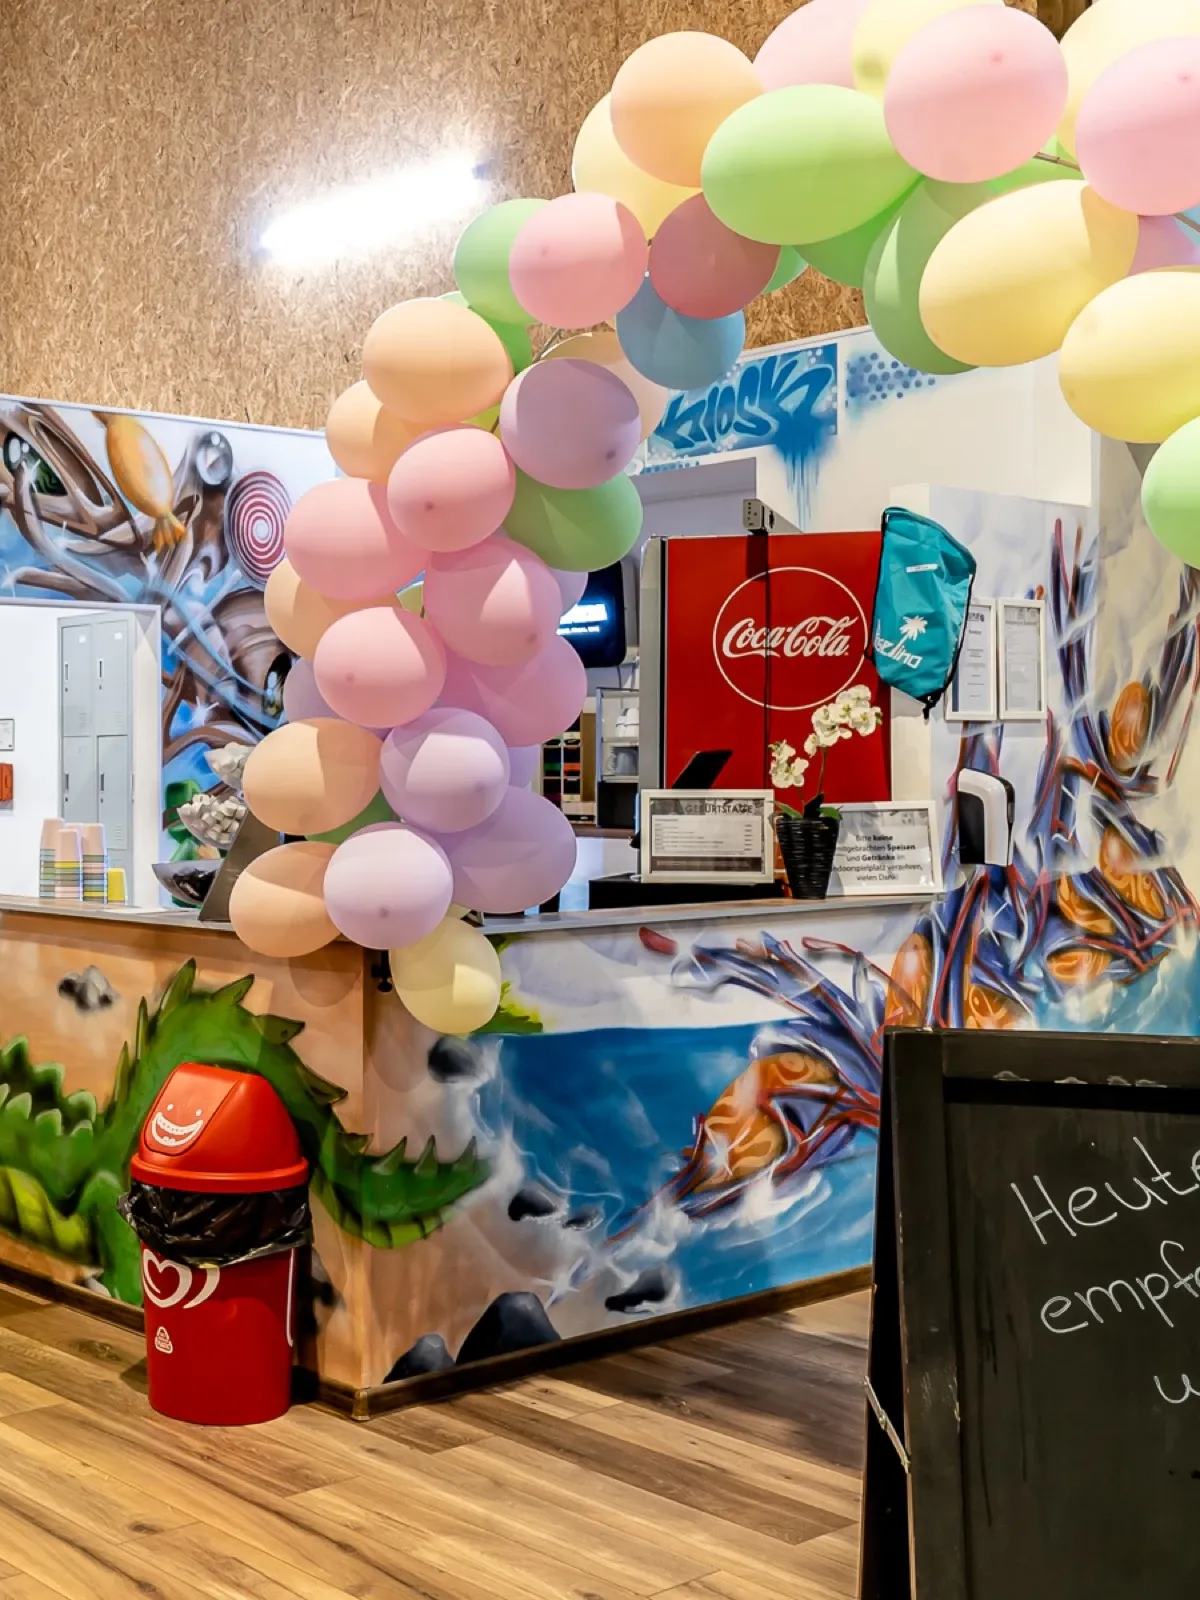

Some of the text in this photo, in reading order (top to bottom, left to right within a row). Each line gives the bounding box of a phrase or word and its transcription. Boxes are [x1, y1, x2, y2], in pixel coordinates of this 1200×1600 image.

[654, 356, 832, 450] KIOSK
[722, 616, 859, 658] Coca-Cola
[832, 864, 885, 872] ndoorspielplatz
[887, 844, 916, 853] Speisen
[1040, 1240, 1200, 1334] empf
